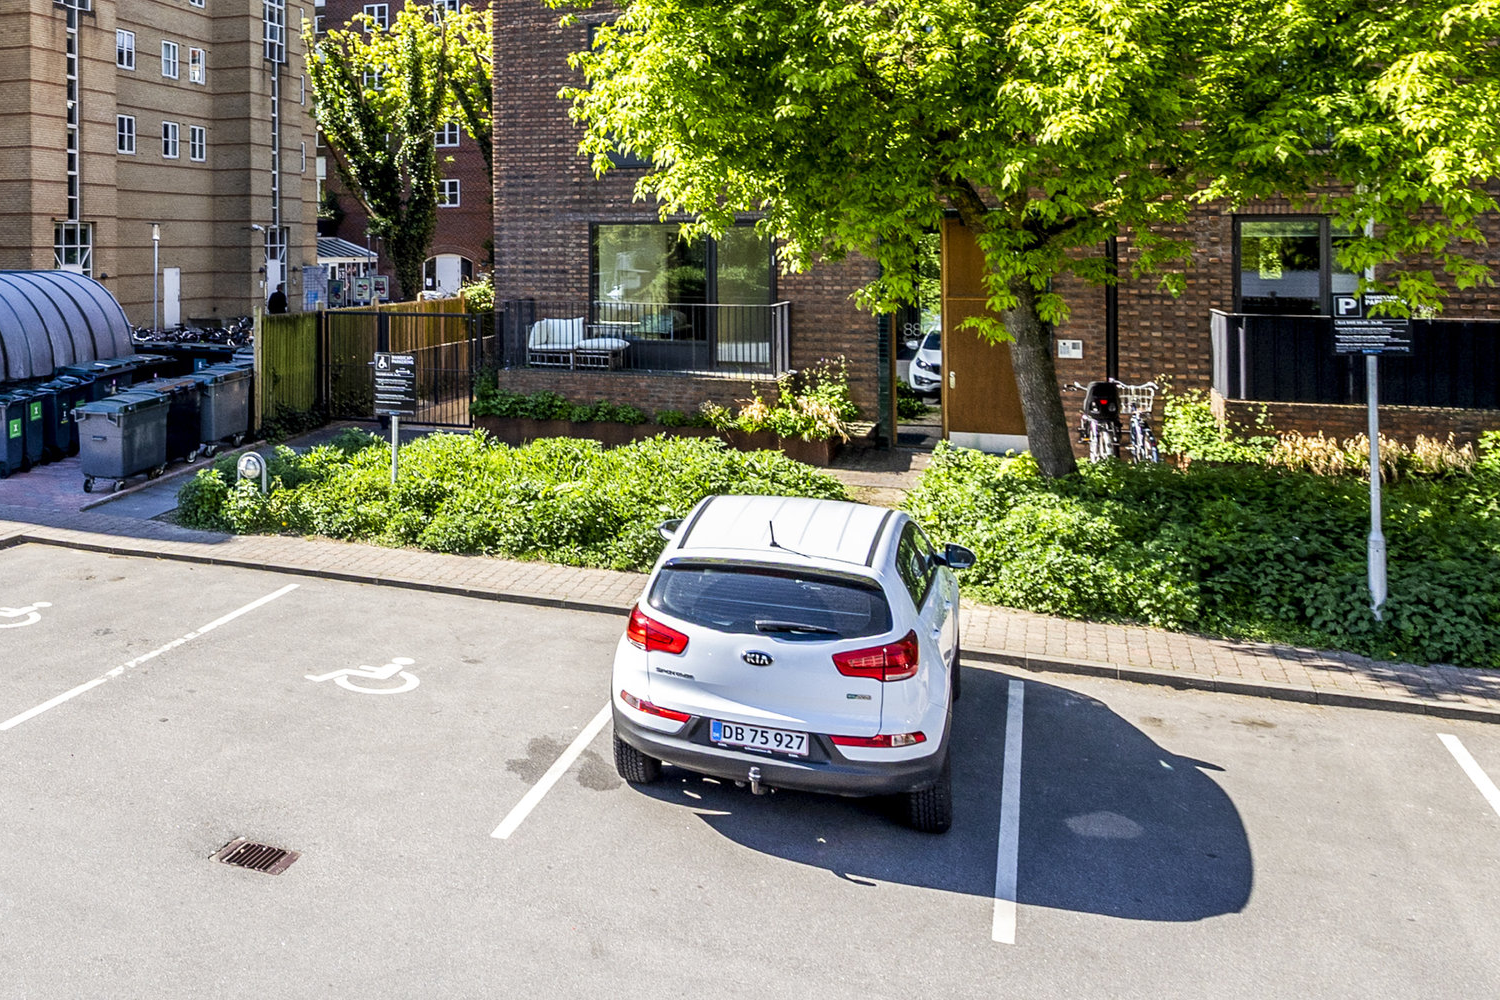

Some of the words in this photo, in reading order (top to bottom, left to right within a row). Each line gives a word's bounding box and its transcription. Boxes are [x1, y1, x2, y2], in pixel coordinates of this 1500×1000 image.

[1338, 297, 1357, 315] P
[746, 654, 769, 664] KIA
[723, 725, 745, 741] DB
[749, 728, 769, 745] 75
[774, 732, 805, 750] 927
